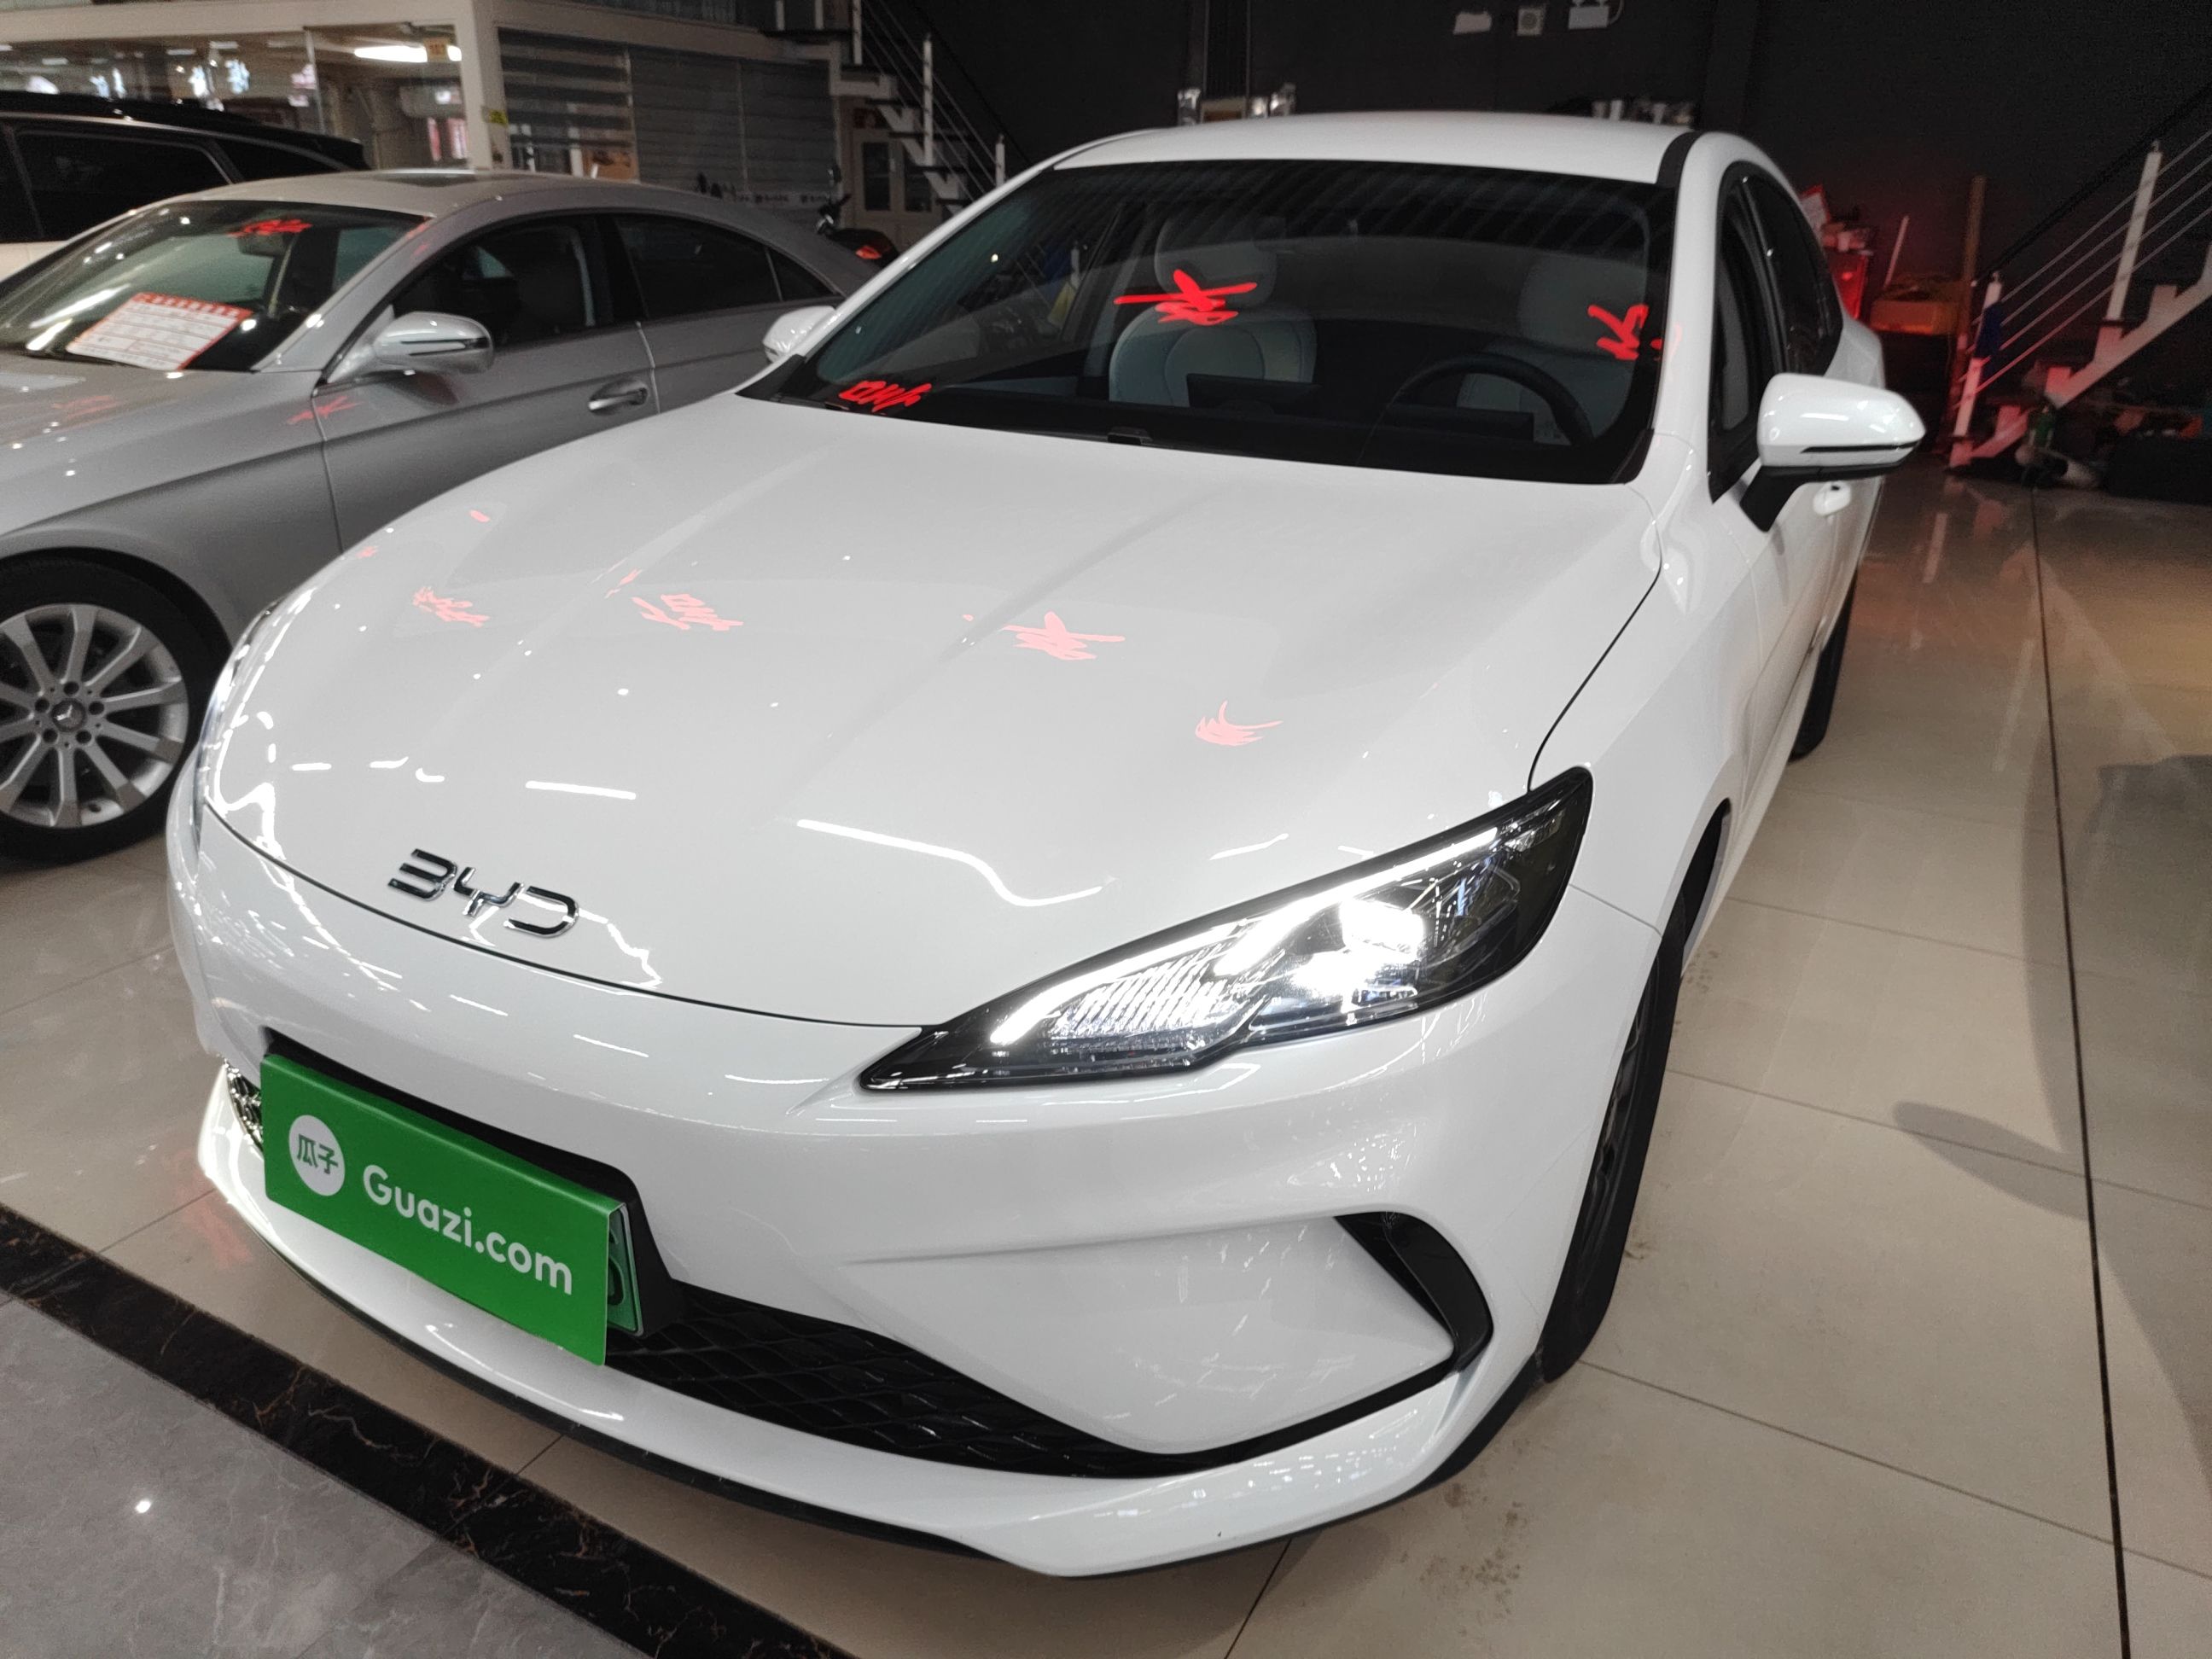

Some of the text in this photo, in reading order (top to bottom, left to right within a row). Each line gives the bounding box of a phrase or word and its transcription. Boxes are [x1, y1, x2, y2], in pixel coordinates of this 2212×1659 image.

[387, 848, 579, 938] BYD
[296, 1133, 339, 1175] 瓜子
[363, 1164, 573, 1295] Guazi.com
